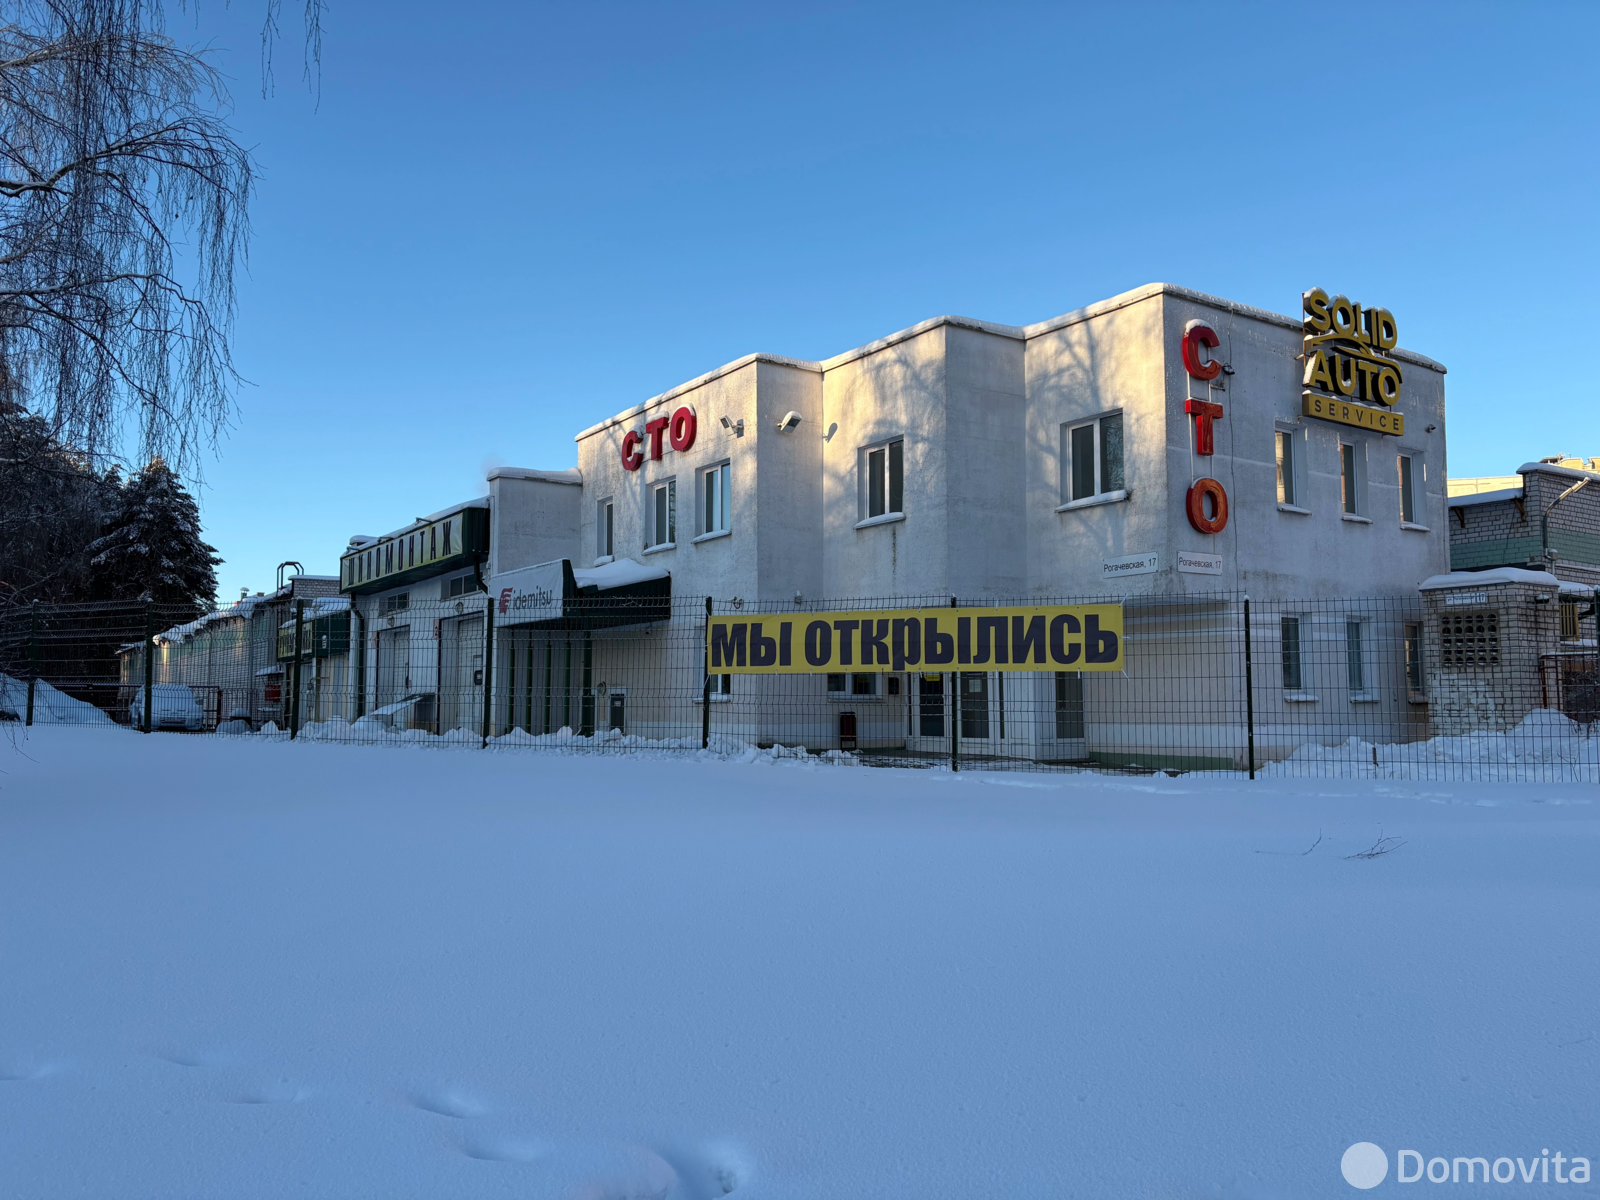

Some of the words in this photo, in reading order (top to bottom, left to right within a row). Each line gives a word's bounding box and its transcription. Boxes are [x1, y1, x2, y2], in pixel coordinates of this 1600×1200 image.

[1304, 290, 1398, 350] SOLID
[1304, 349, 1402, 406] AUTO
[621, 405, 697, 472] СТО
[1182, 320, 1230, 534] СТО
[1314, 399, 1400, 431] SERVICE
[348, 520, 452, 585] ШИНОМОНТАЖ
[1104, 561, 1146, 572] Рогачевская,
[1148, 557, 1157, 567] 17
[1179, 557, 1214, 569] Рогачевская,
[1215, 560, 1222, 569] 17
[512, 588, 552, 611] idemitsu
